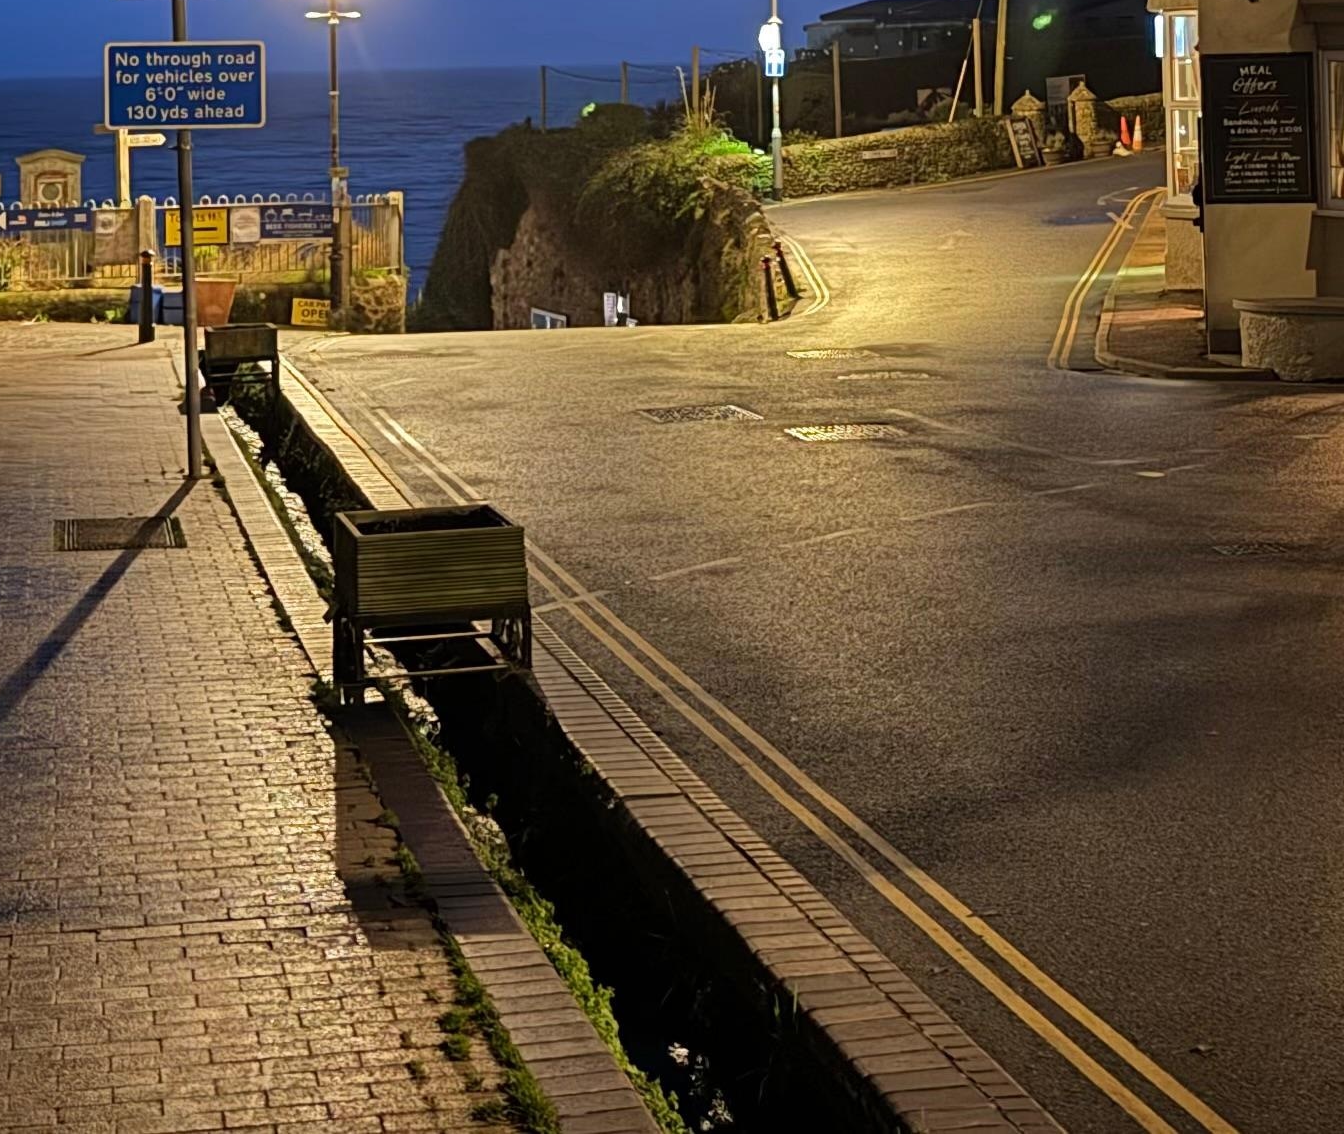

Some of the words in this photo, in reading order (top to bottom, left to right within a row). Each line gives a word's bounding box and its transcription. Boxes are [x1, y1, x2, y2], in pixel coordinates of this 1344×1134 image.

[115, 52, 140, 66] No
[146, 51, 212, 68] through
[217, 51, 255, 65] road
[115, 70, 138, 84] for
[145, 69, 213, 83] vehicles
[218, 72, 255, 82] over
[1239, 66, 1272, 76] MEAL
[187, 86, 226, 101] wide
[1233, 78, 1278, 94] Offers
[126, 106, 157, 120] 130
[160, 106, 188, 122] yds
[194, 105, 245, 119] ahead
[1239, 100, 1279, 116] Lunch
